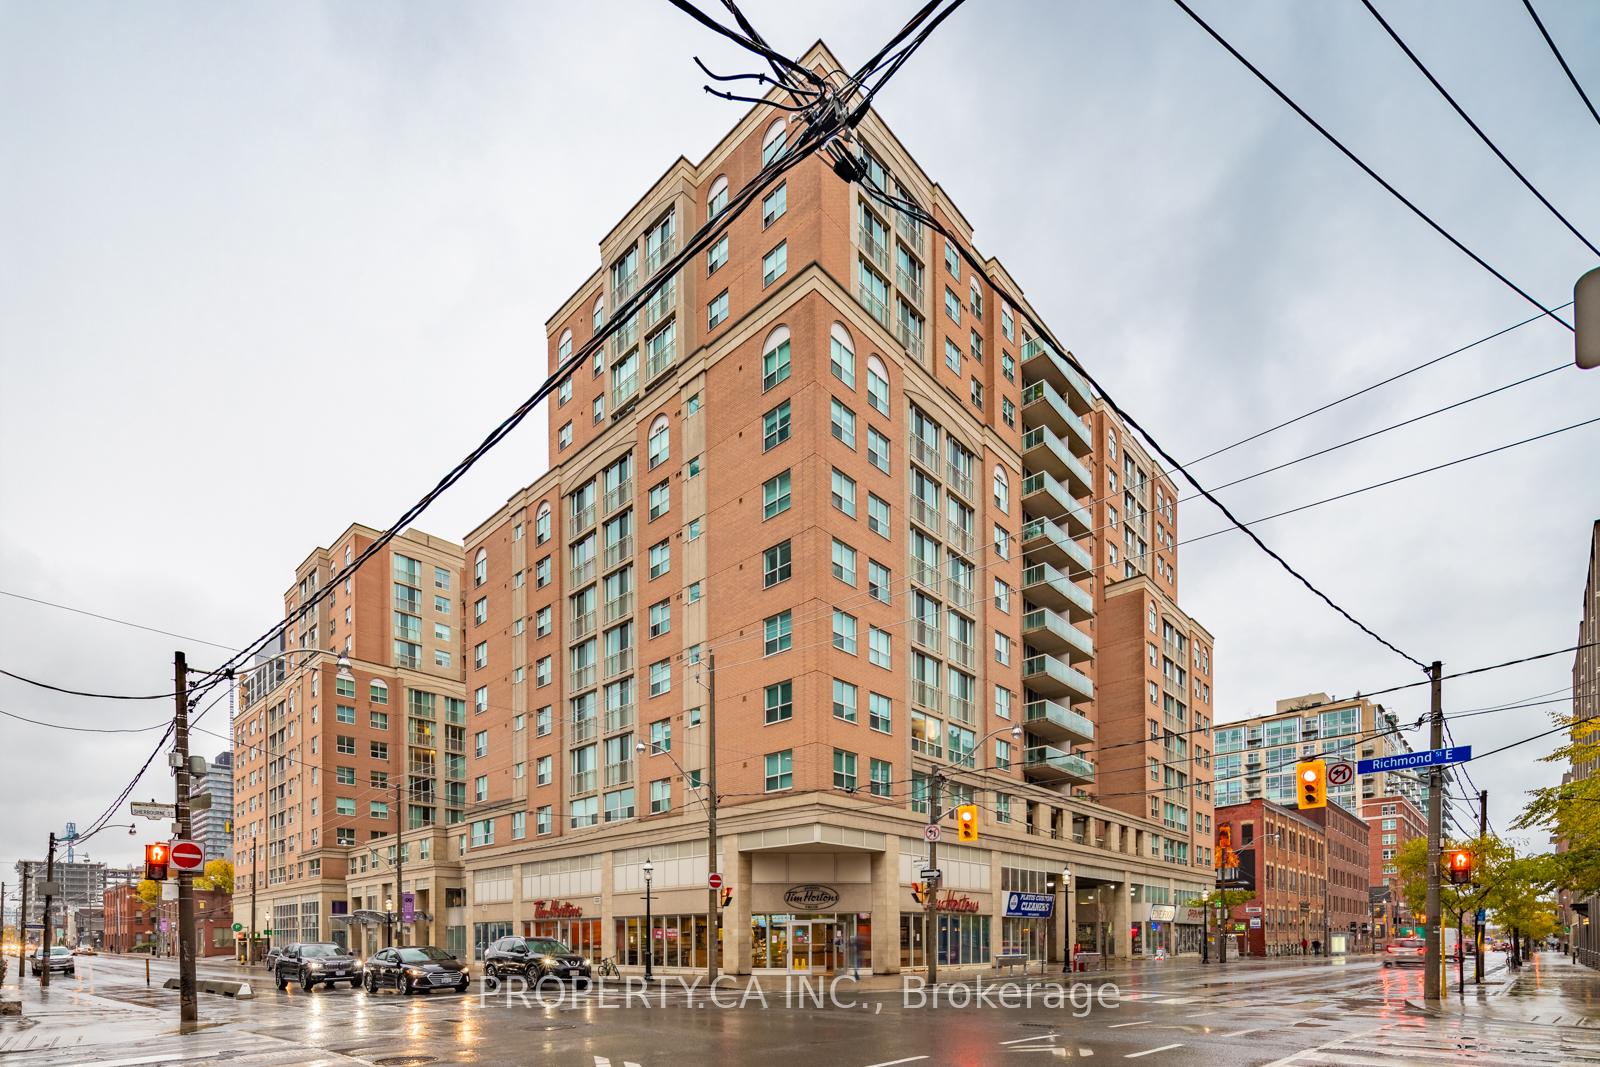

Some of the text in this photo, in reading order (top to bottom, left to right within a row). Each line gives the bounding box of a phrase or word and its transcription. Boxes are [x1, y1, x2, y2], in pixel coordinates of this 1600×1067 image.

[1372, 752, 1432, 770] Richmond
[1445, 749, 1453, 760] E
[785, 890, 838, 902] Tim Hortons
[1021, 901, 1049, 912] CLEANERS
